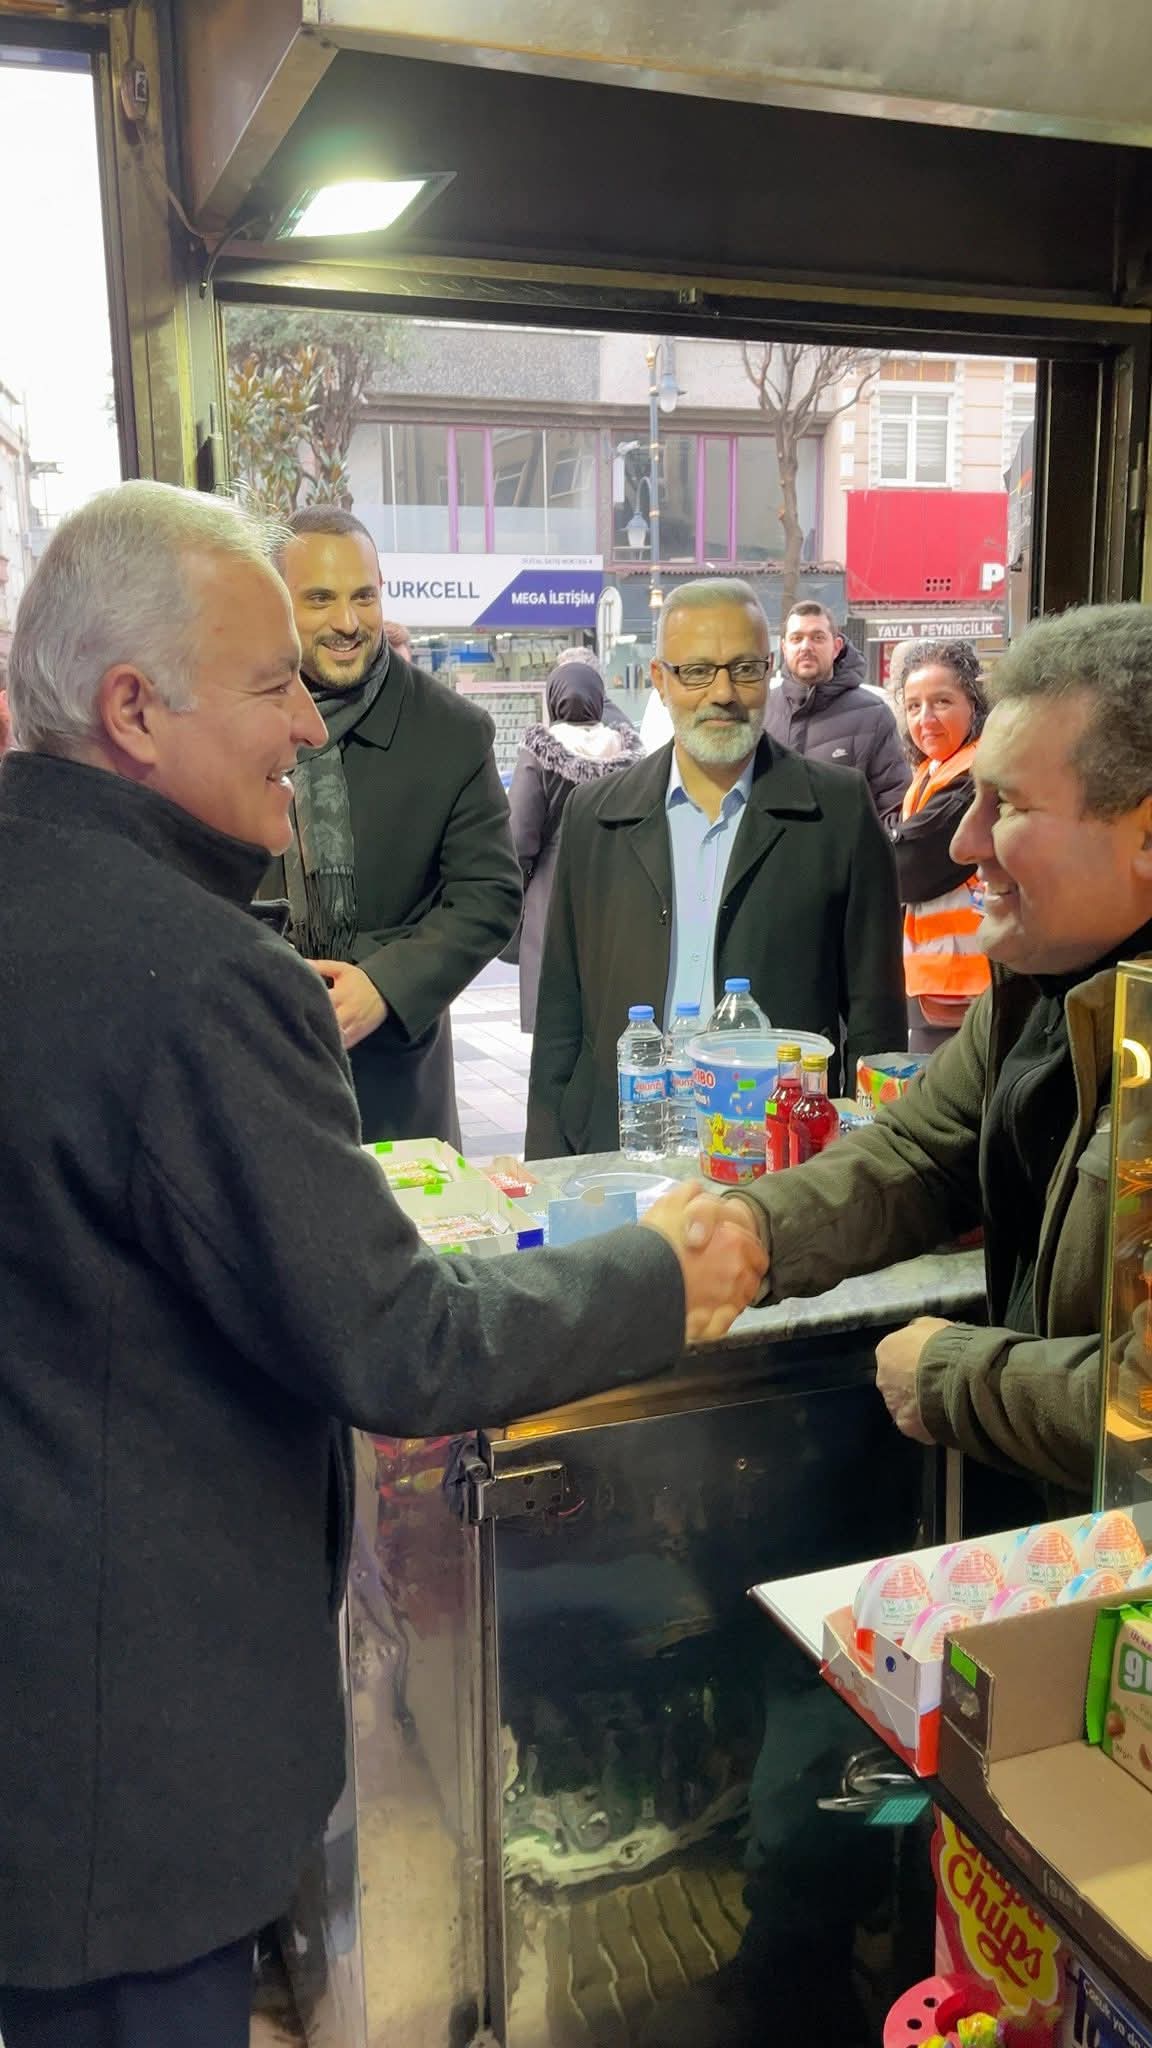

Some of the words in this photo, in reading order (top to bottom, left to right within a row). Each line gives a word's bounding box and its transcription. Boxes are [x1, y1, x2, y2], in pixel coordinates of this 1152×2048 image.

[383, 580, 480, 599] URKCELL
[511, 591, 547, 605] MEGA
[549, 589, 595, 607] İLETİŞİM
[878, 625, 915, 637] YAYLA
[948, 1854, 1043, 1988] Chups
